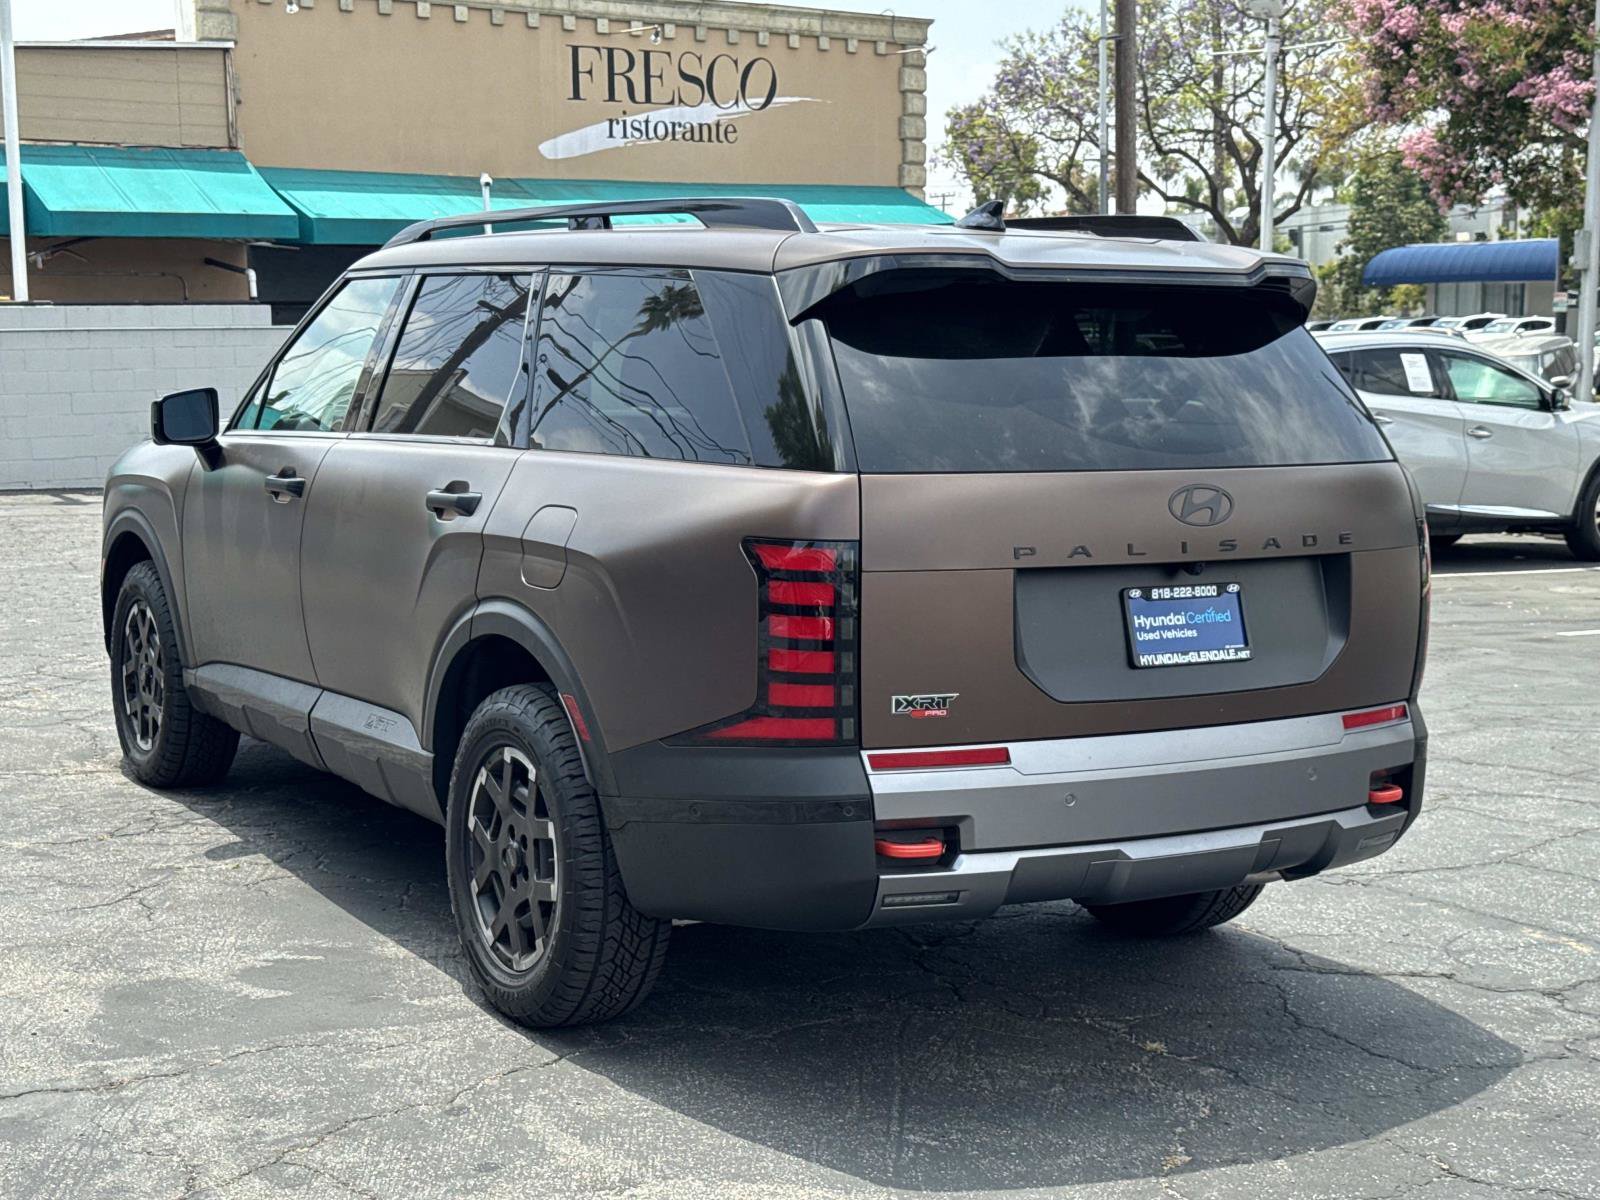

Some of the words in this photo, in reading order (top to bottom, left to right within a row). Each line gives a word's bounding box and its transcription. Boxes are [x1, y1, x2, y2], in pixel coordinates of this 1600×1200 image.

[566, 44, 777, 111] FRESCO
[606, 110, 739, 144] ristorante
[1013, 532, 1354, 560] PALISADE
[1151, 585, 1218, 600] 818-222-8000
[1134, 612, 1186, 629] Hyundai
[1186, 607, 1232, 624] Certified
[1136, 630, 1160, 641] Used
[1160, 628, 1198, 640] Vehicles
[891, 693, 960, 714] XRT
[924, 709, 947, 717] PRO
